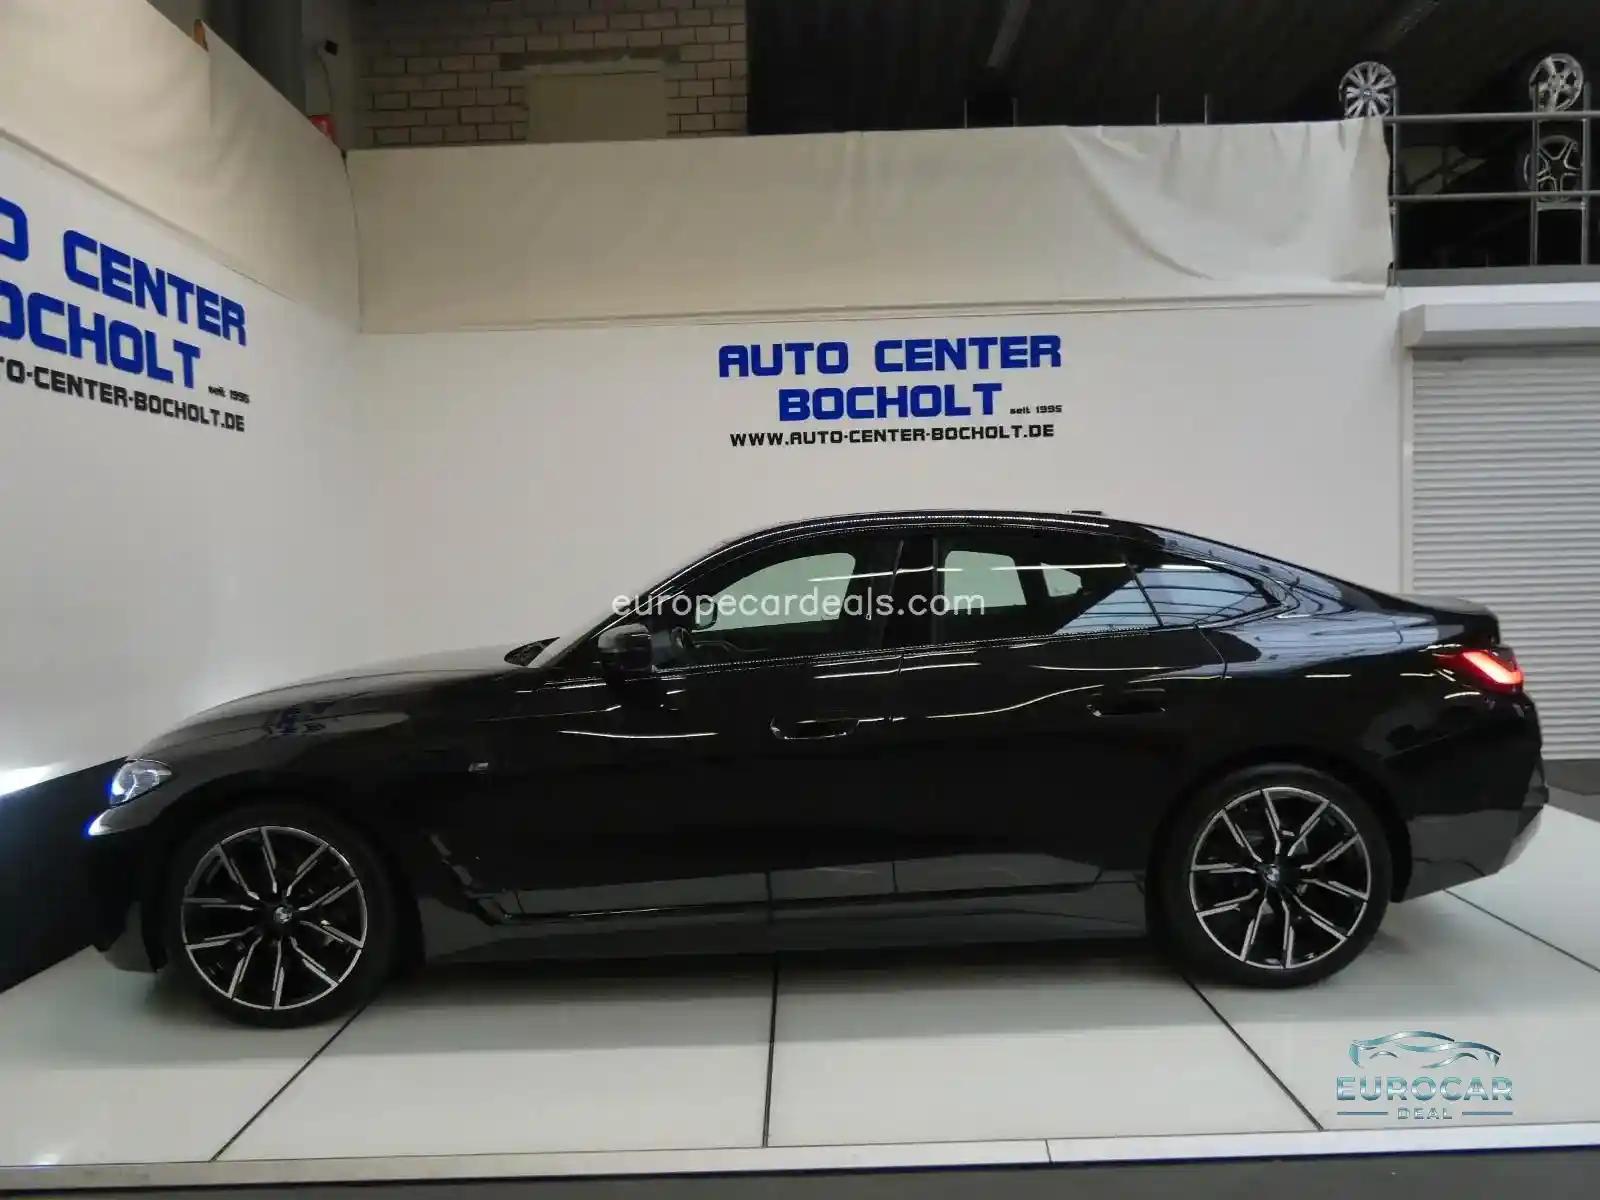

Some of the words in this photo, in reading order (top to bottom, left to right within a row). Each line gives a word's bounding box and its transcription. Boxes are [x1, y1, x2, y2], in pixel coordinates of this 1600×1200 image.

[63, 229, 247, 347] CENTER
[718, 341, 849, 378] AUTO
[874, 334, 1062, 373] CENTER
[0, 356, 246, 432] O-CENTER-BOCHOLT.DE
[778, 382, 1003, 422] BOCHOLT
[1009, 405, 1031, 415] seit
[1035, 404, 1063, 414] 1995
[730, 423, 1055, 447] WWW.AUTO-CENTER-BOCHOLT.DE
